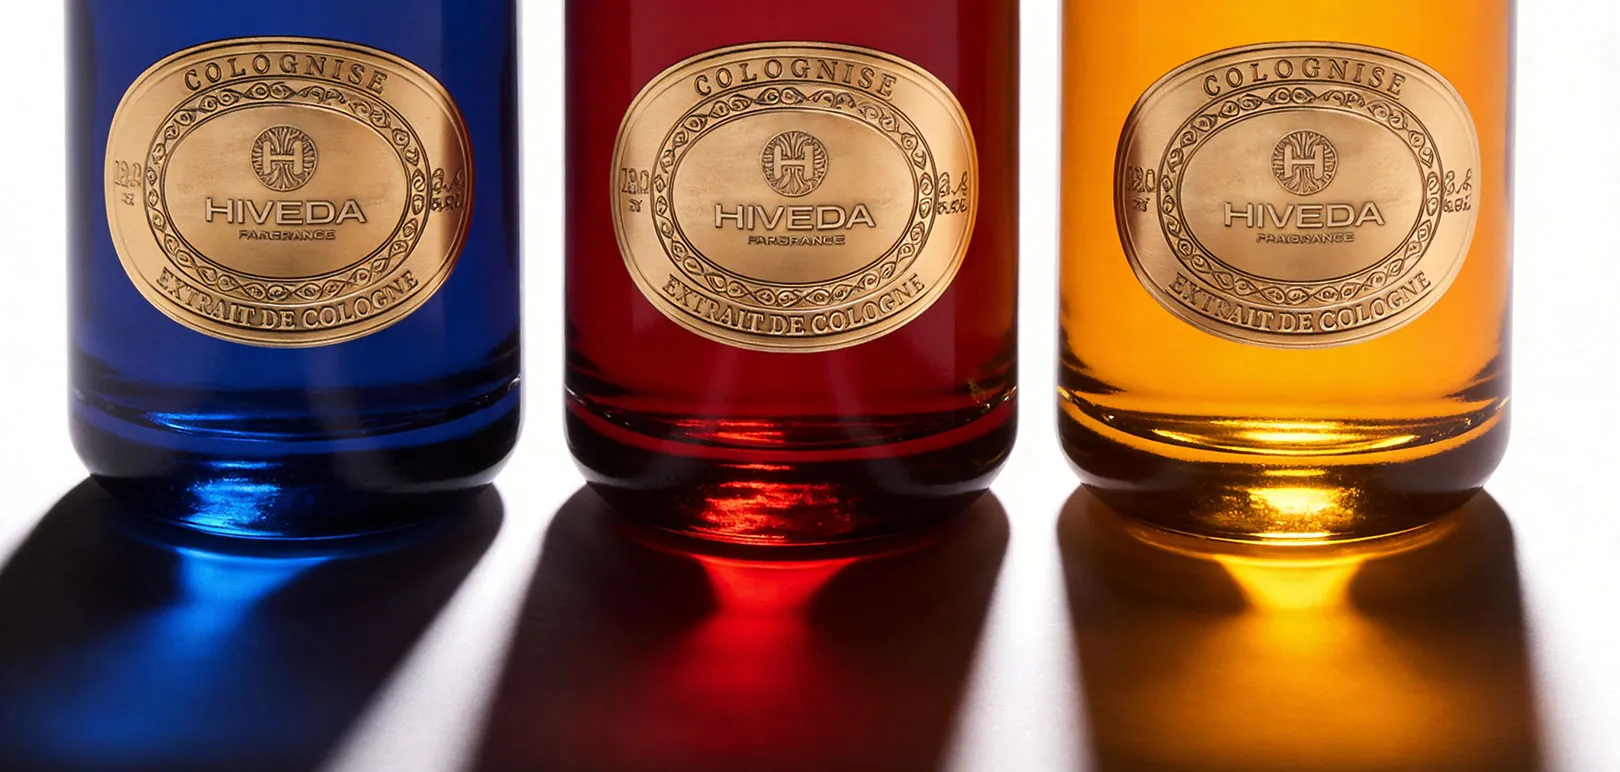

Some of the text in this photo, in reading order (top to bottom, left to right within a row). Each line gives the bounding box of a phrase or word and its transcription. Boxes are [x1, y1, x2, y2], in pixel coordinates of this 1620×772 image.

[184, 53, 388, 94] COLOGNISE
[694, 58, 897, 98] COLOGNISE
[1203, 57, 1407, 98] COLOGNISE
[263, 141, 303, 176] H
[775, 145, 813, 180] H
[1284, 145, 1322, 179] H
[205, 198, 367, 225] HIVEDA
[714, 203, 876, 231] HIVEDA
[1224, 202, 1386, 229] HIVEDA
[156, 267, 418, 329] EXTRAIT DE COLOGNE
[662, 273, 926, 336] EXTRAIT DE COLOGNE
[1168, 270, 1431, 334] EXTRAIT DE COLOGNE
